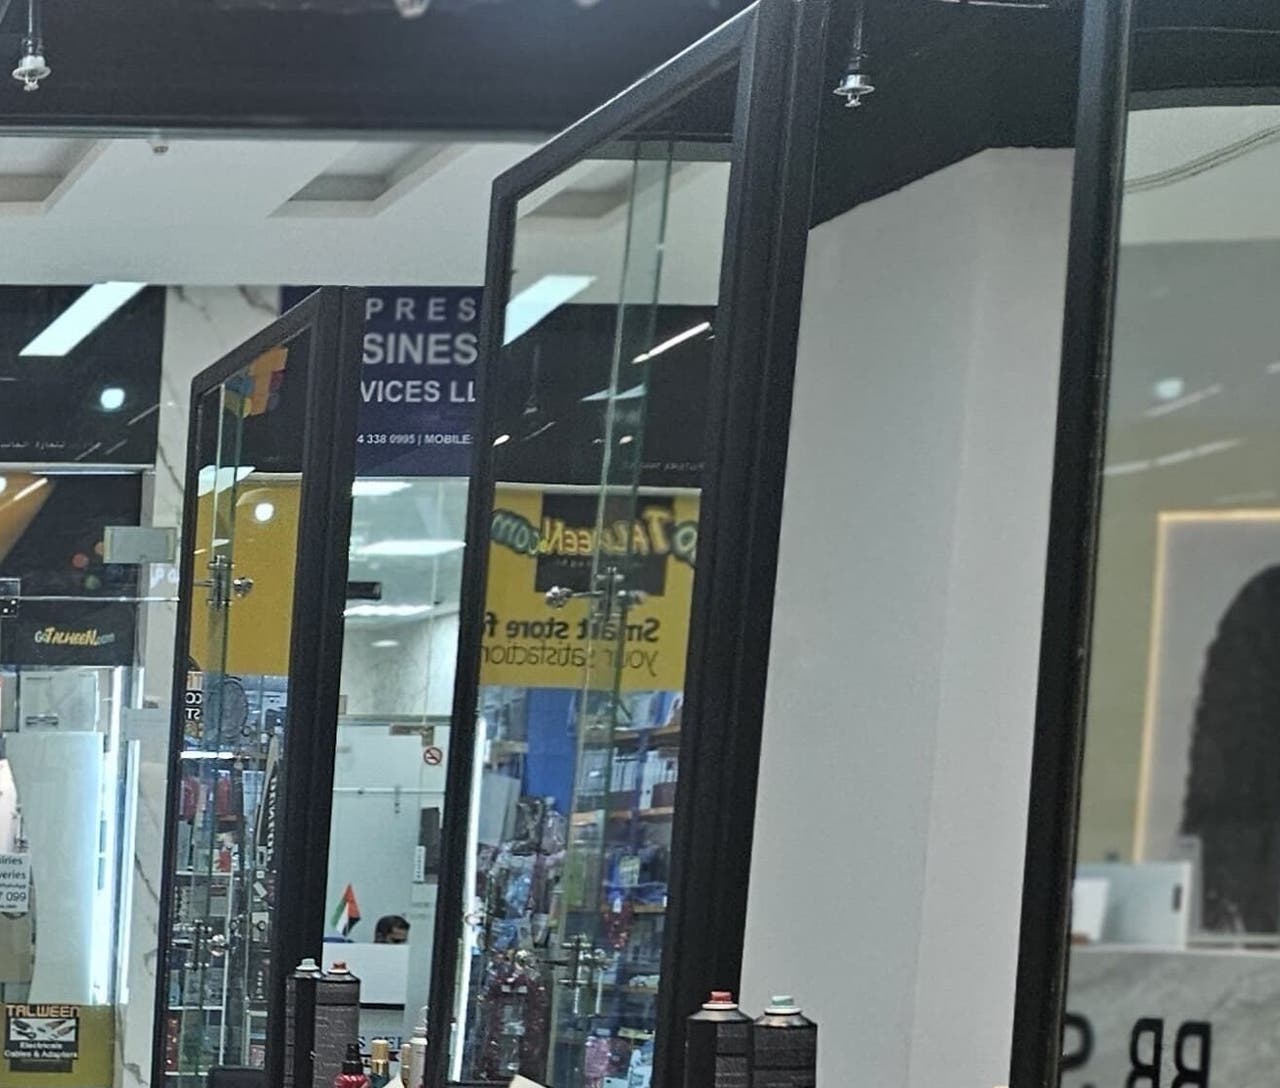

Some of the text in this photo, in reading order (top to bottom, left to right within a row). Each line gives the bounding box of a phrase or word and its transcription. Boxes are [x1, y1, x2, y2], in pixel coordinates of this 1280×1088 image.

[362, 332, 478, 364] SINES
[360, 380, 441, 403] VICES
[5, 1004, 81, 1018] TALWEEN
